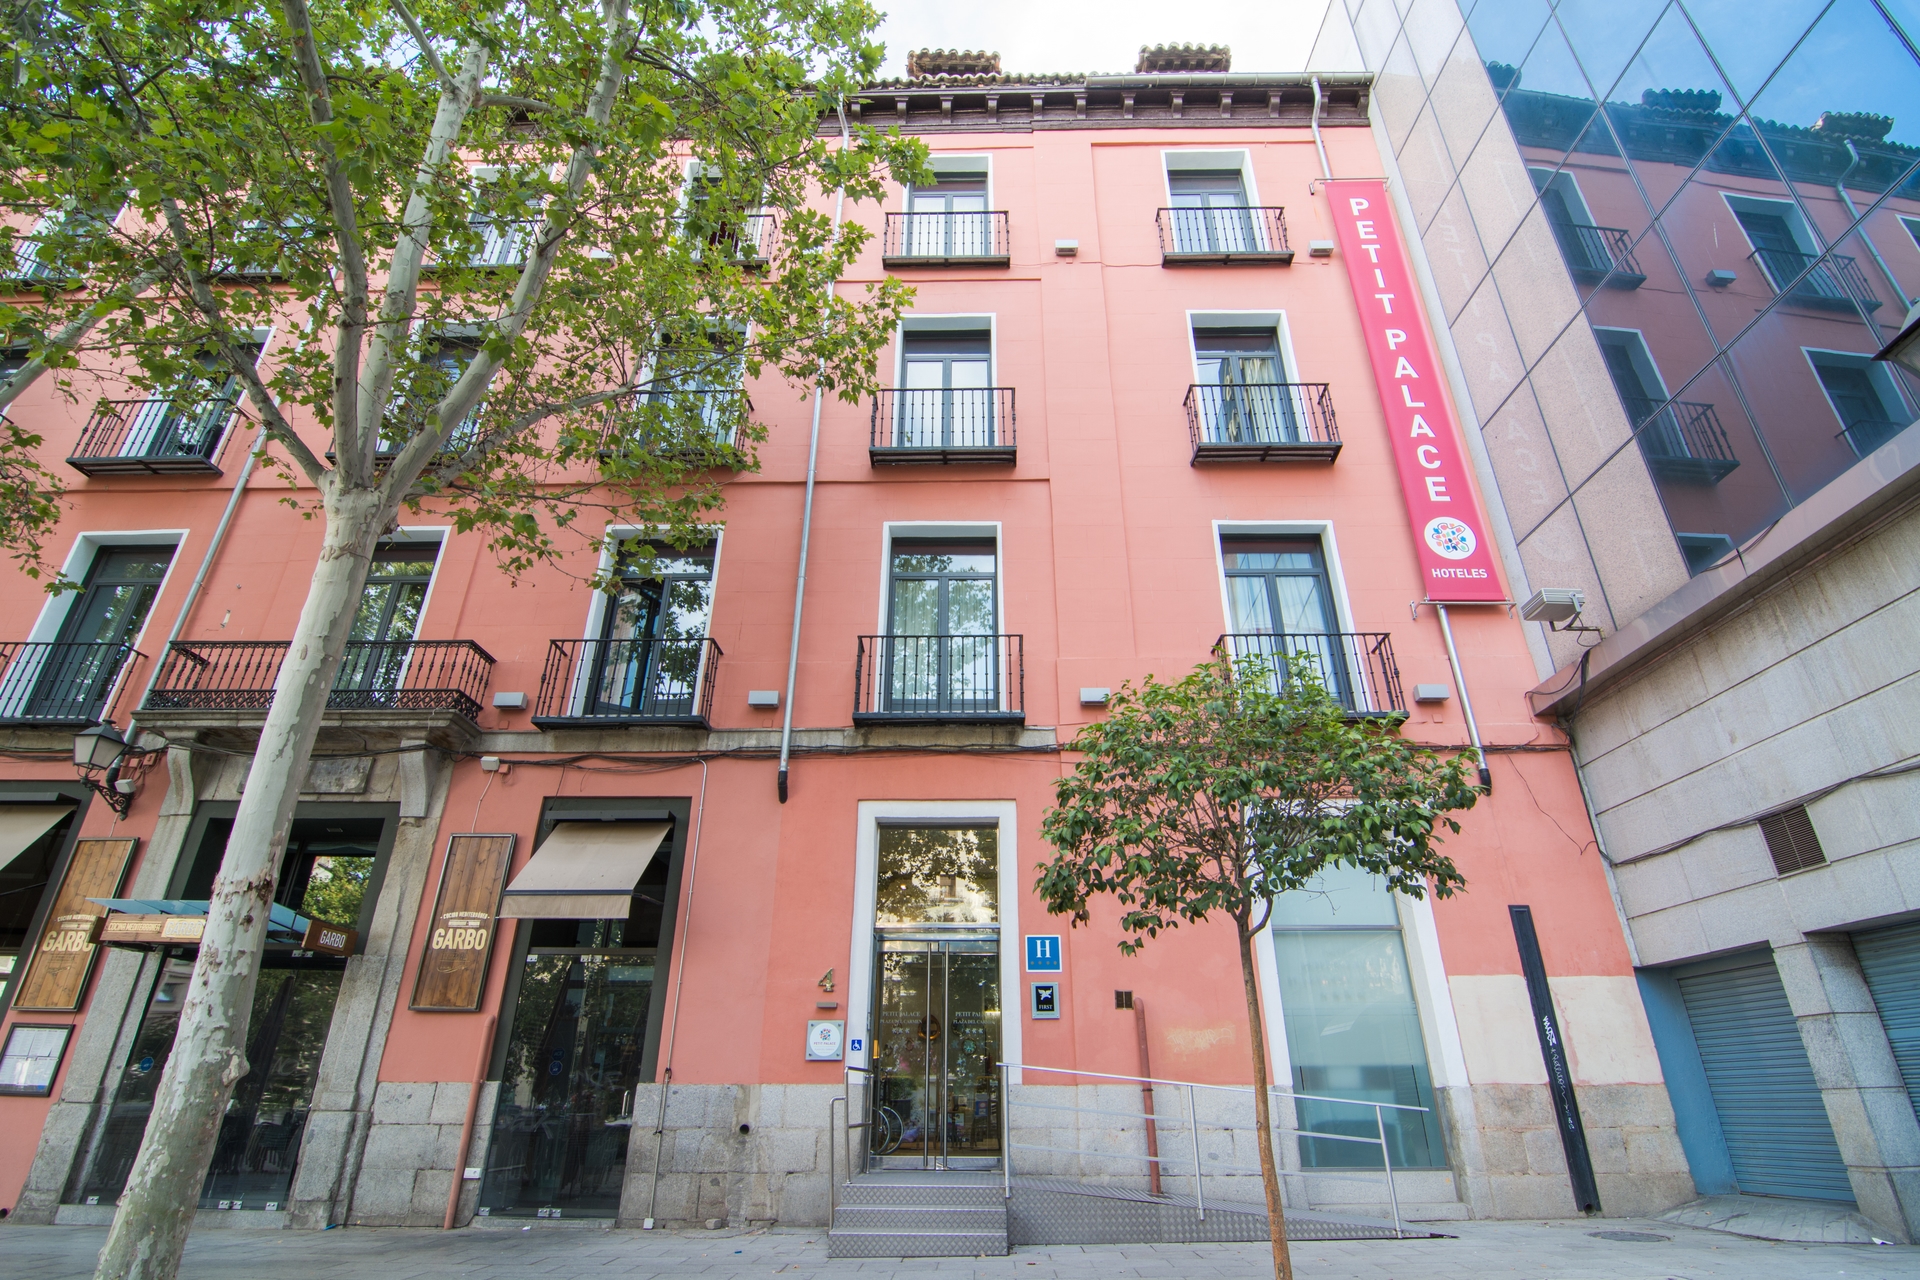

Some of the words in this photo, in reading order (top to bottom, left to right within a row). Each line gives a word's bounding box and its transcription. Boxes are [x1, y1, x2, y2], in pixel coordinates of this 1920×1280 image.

[1349, 198, 1395, 314] PETIT
[1385, 329, 1451, 502] PALACE
[1431, 568, 1488, 578] HOTELES
[165, 921, 204, 936] GARBO
[320, 930, 346, 948] GARBO
[432, 928, 487, 950] GARBO
[1036, 940, 1051, 958] H
[818, 967, 835, 992] 4
